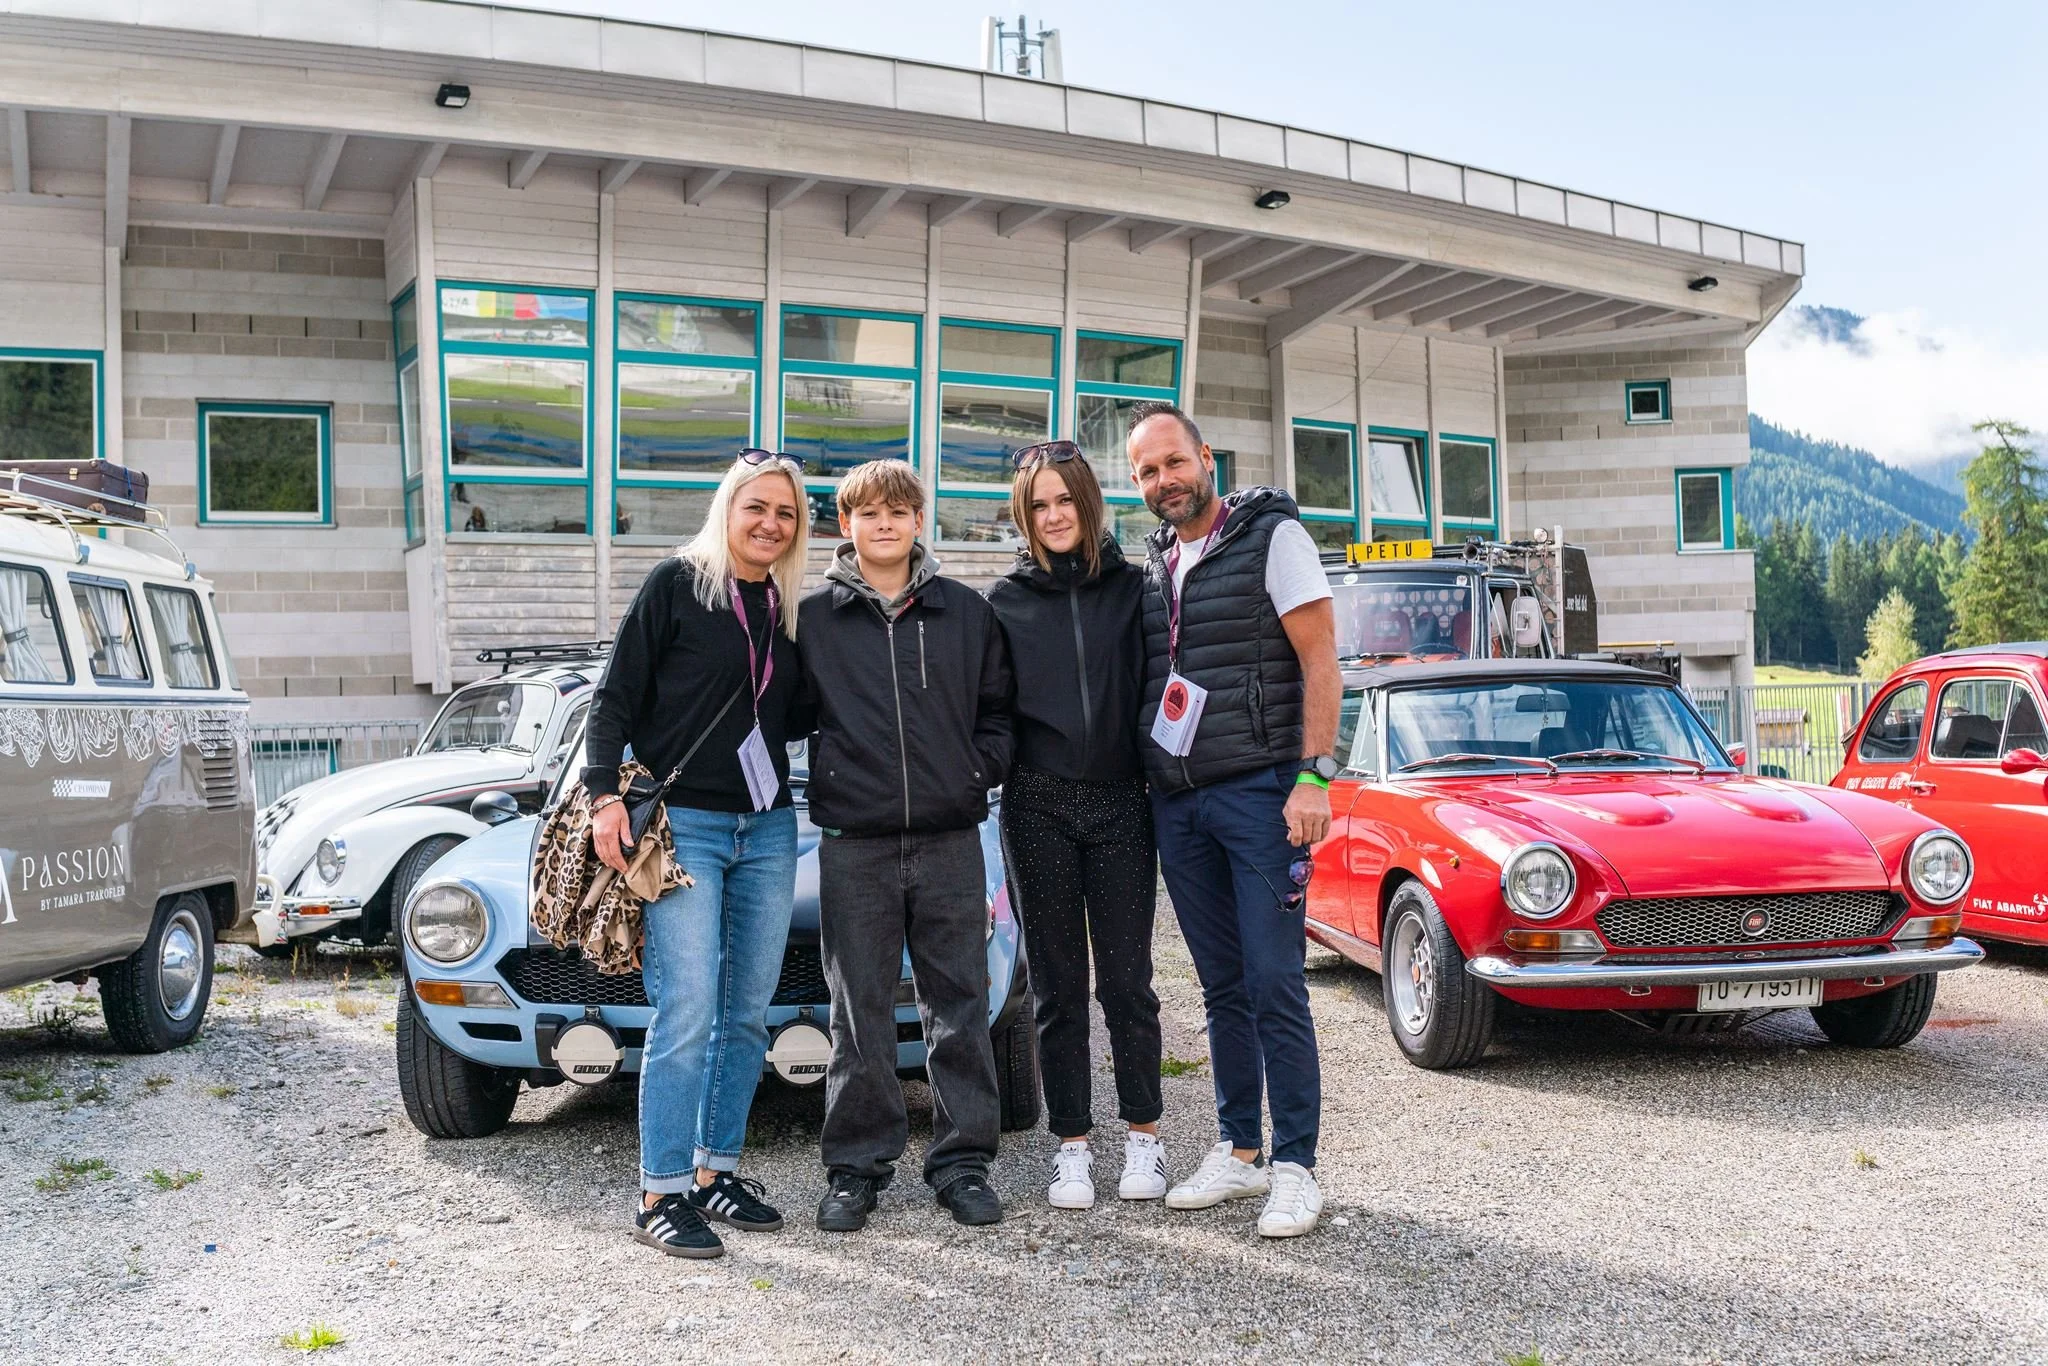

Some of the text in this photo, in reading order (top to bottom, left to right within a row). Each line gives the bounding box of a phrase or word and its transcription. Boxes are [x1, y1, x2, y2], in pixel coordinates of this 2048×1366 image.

[1366, 542, 1412, 559] PETU
[22, 844, 125, 891] PASSION
[40, 898, 52, 911] BY
[54, 893, 83, 909] TAMARA
[1973, 898, 2035, 916] FIAT ABARTH
[574, 1065, 611, 1073] FIAT
[790, 1064, 827, 1073] FIAT
